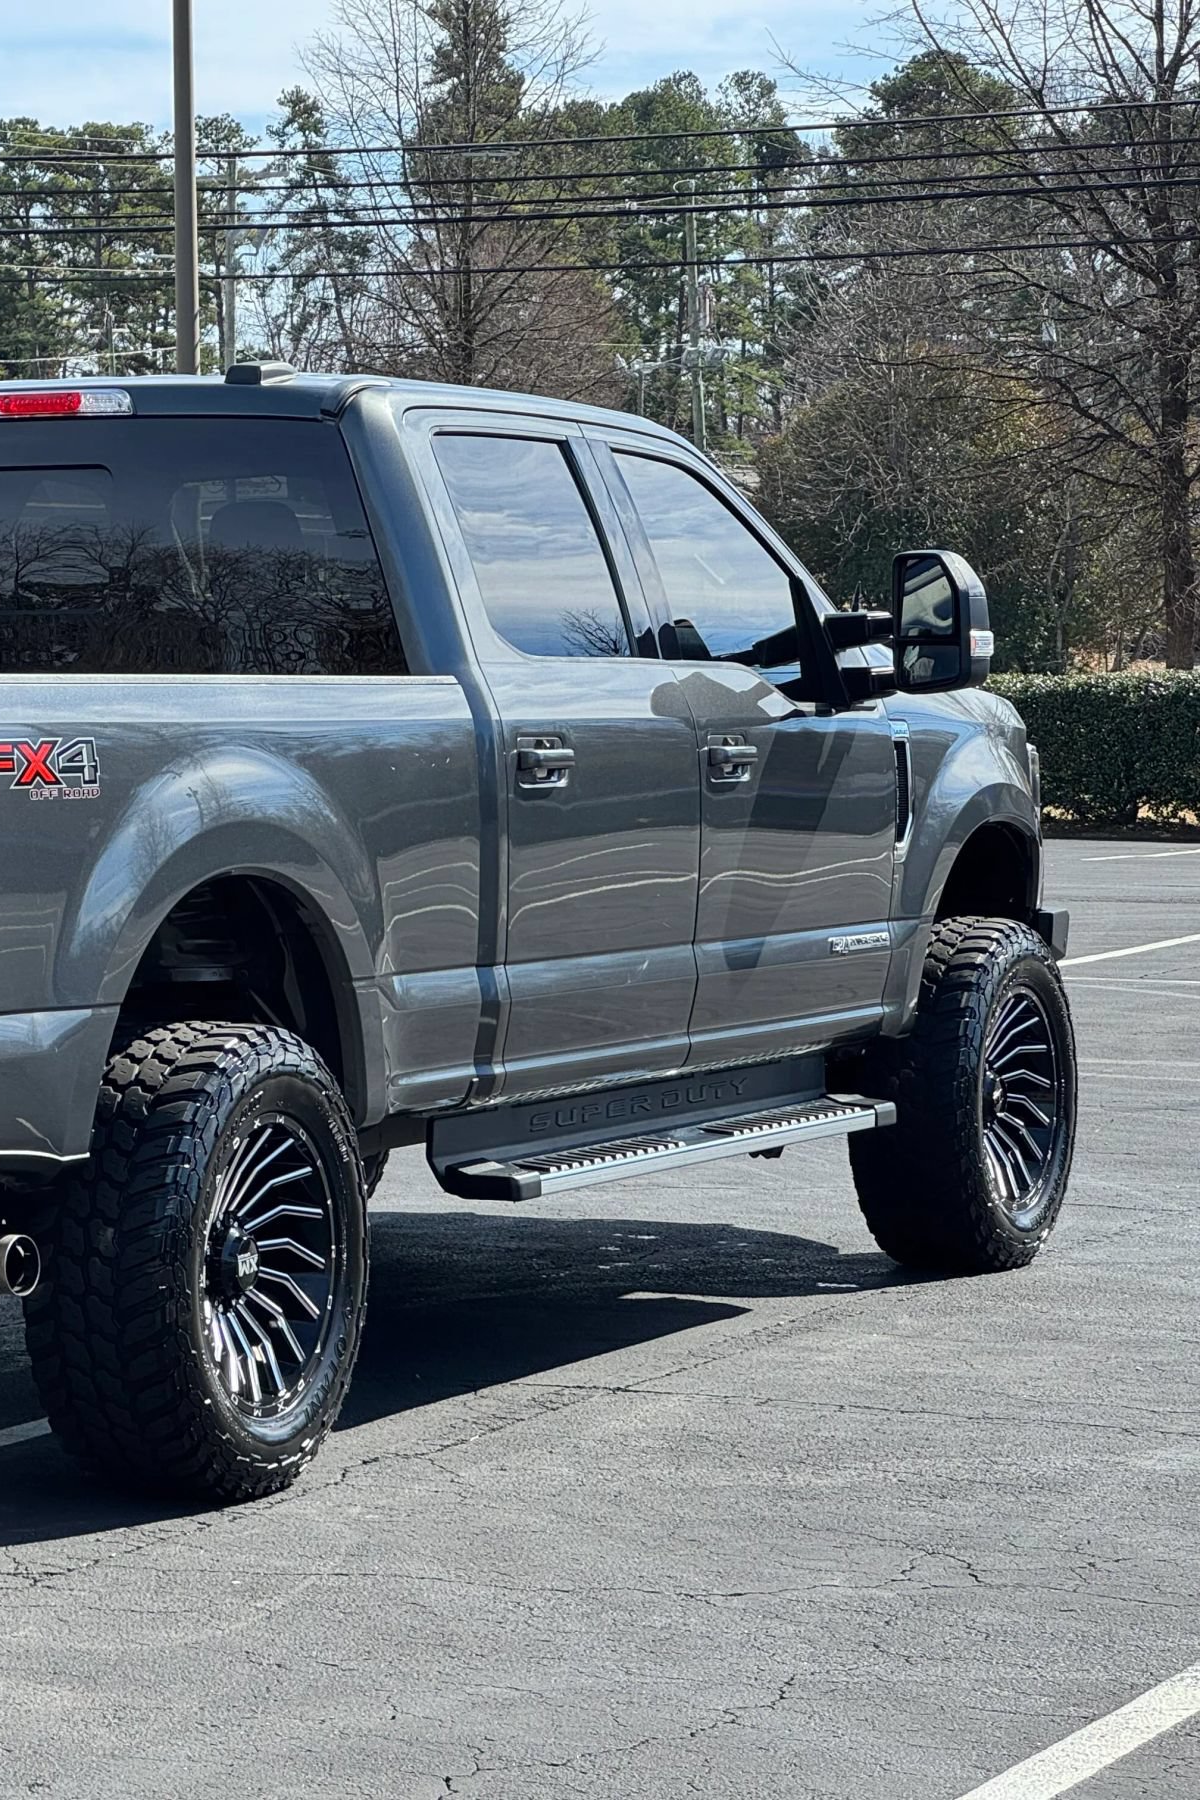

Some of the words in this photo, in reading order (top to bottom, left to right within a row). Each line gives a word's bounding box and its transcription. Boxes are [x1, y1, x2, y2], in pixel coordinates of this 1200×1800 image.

[29, 788, 58, 800] OFF
[62, 787, 100, 799] ROAD
[530, 1095, 651, 1133] SUPER
[661, 1077, 749, 1110] DUTY
